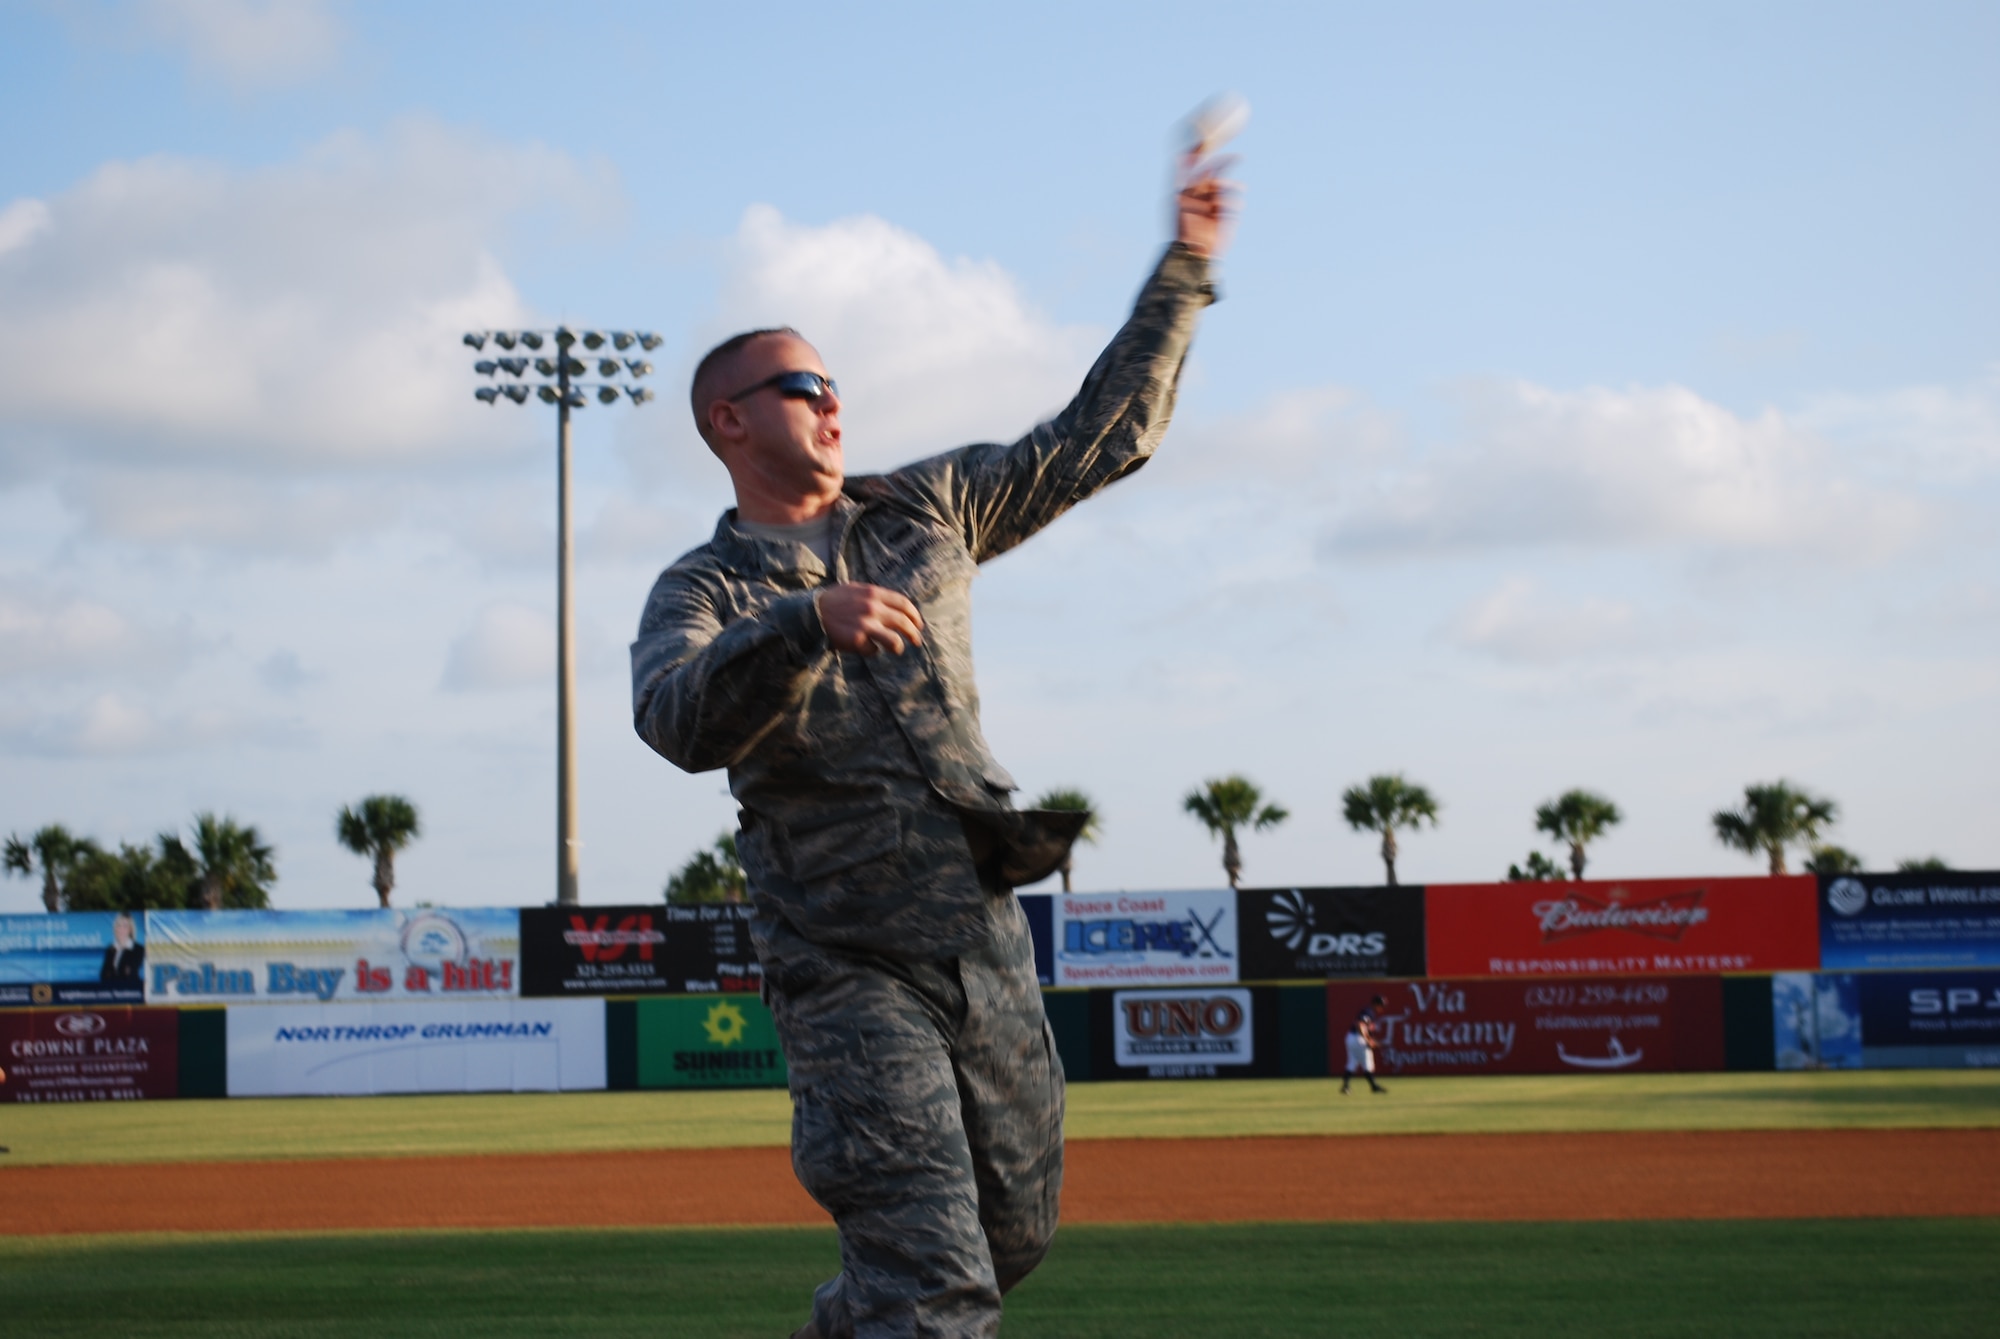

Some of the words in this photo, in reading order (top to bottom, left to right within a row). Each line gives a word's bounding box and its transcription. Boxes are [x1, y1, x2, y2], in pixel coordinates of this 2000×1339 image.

[1064, 898, 1113, 915] Space
[1118, 897, 1165, 912] Coast
[1532, 898, 1709, 932] Budweiser
[1307, 932, 1387, 955] DRS
[151, 962, 256, 995] Palm
[266, 962, 344, 1001] Bay
[356, 958, 392, 992] is
[404, 965, 431, 992] a
[441, 958, 514, 992] hit!
[1409, 982, 1465, 1013] Via
[1121, 995, 1243, 1039] UNO
[275, 1024, 416, 1042] NORTHROP
[421, 1020, 553, 1039] GRUMMAN
[1377, 1006, 1516, 1060] Tuscany
[10, 1038, 86, 1057] CROWNE
[93, 1037, 149, 1054] PLAZA
[673, 1050, 779, 1071] SUNBELT
